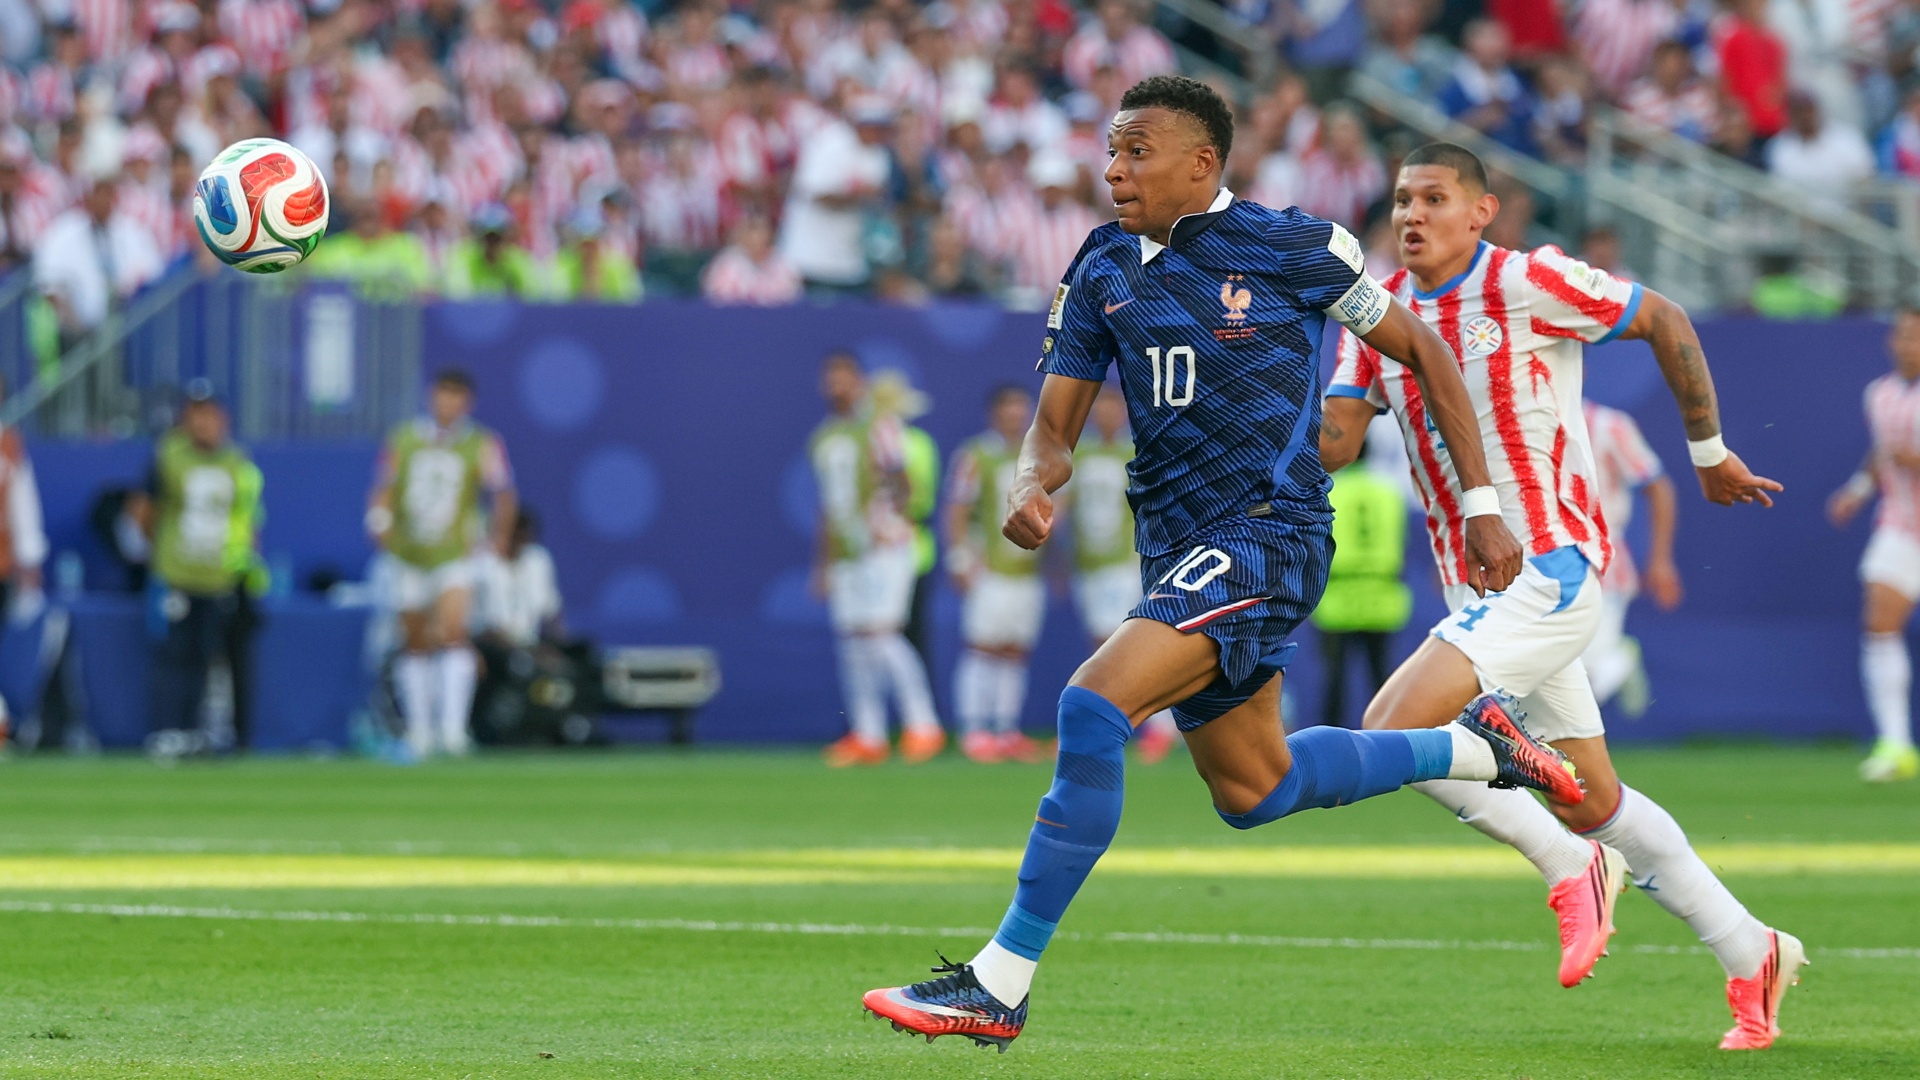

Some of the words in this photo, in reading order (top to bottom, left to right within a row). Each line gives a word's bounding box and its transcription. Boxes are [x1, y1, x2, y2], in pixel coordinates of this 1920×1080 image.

[1339, 279, 1367, 311] FOOTBALL
[1344, 284, 1374, 320] UNITES
[1352, 315, 1366, 327] the
[1364, 290, 1381, 316] World
[1146, 345, 1196, 407] 10
[1159, 545, 1231, 592] 10
